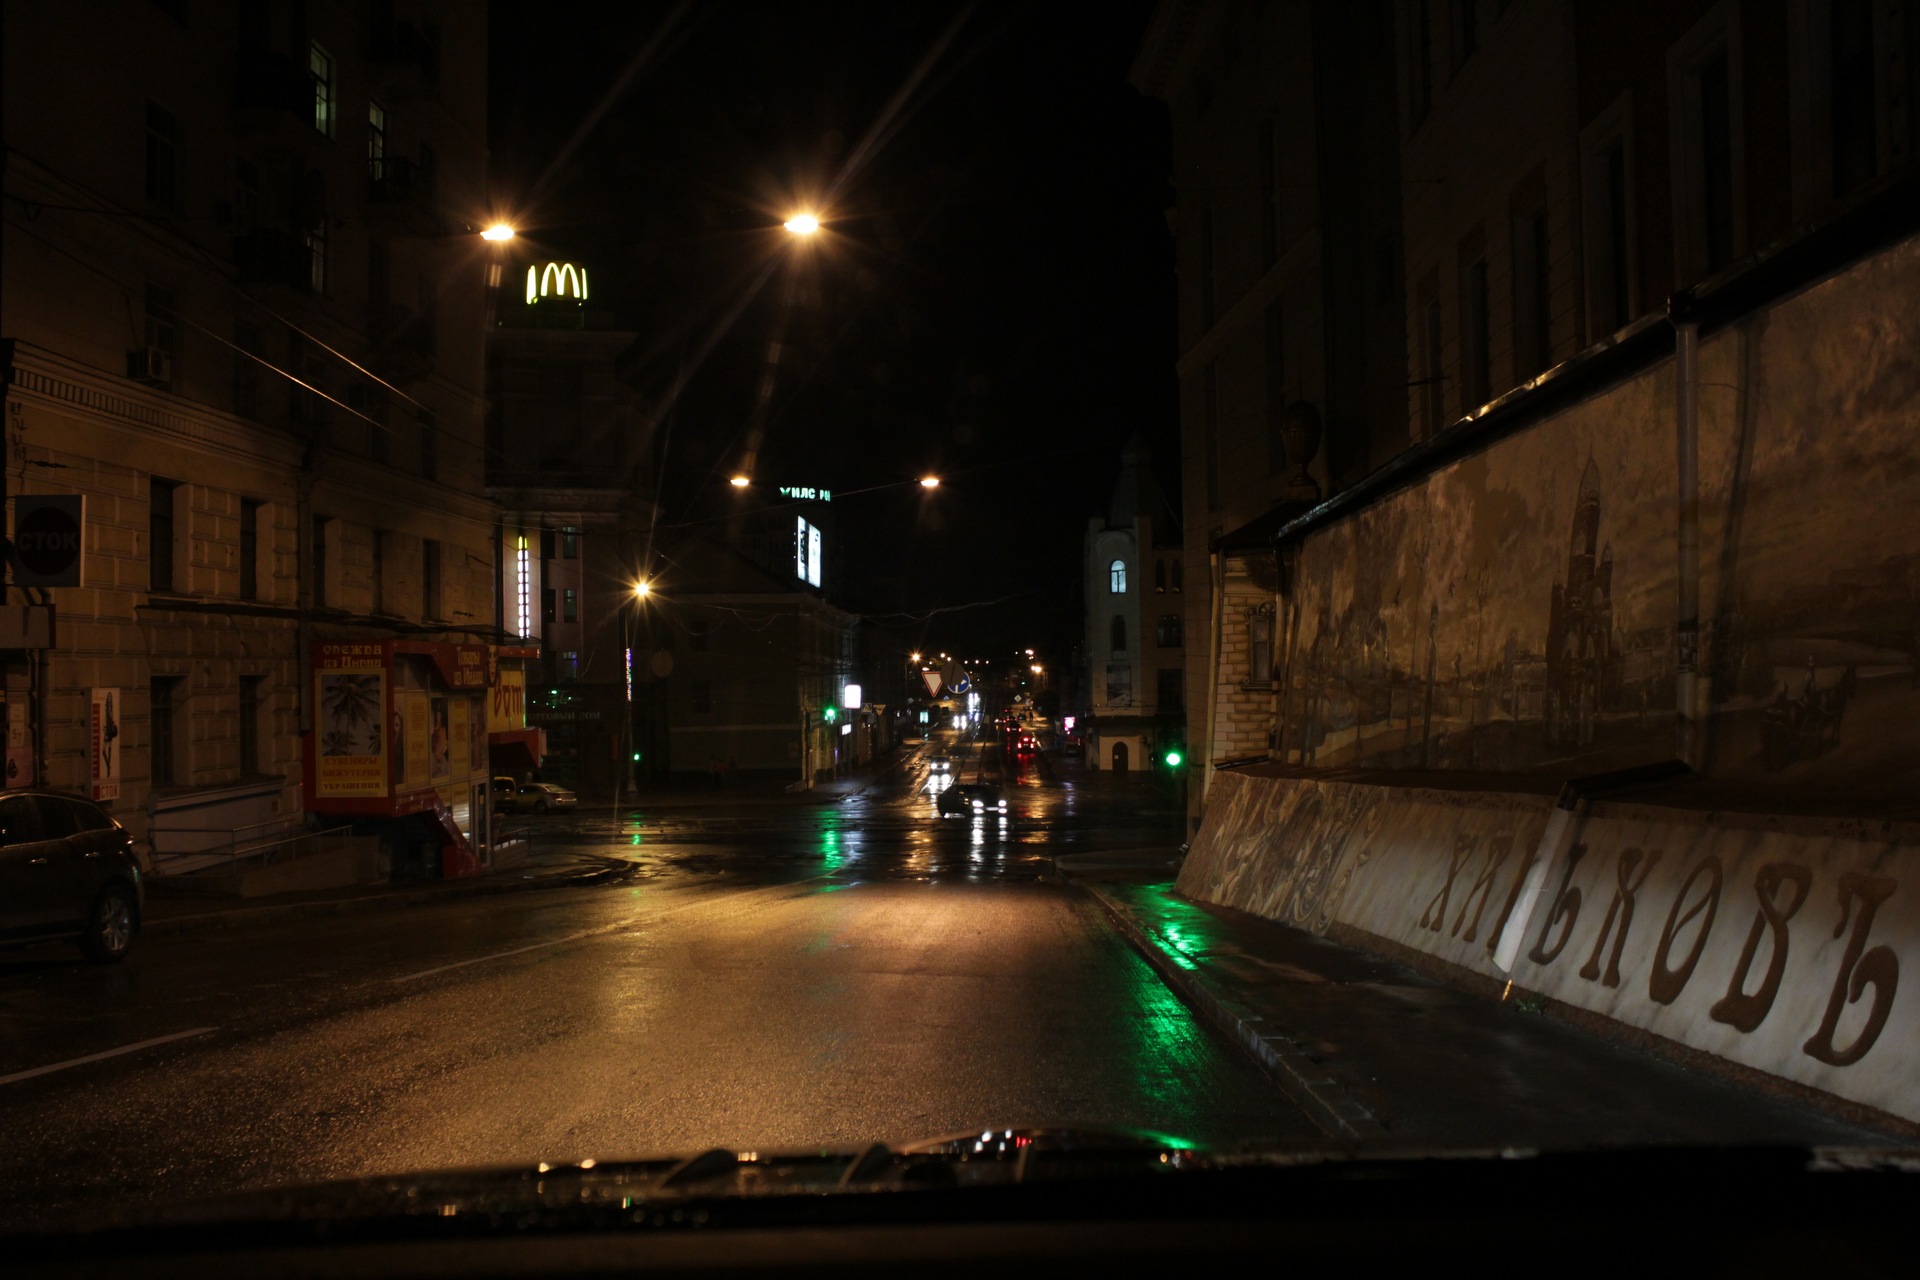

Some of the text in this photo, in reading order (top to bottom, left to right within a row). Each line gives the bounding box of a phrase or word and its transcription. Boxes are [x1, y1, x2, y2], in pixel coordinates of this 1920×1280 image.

[17, 531, 79, 552] СТОК
[324, 757, 378, 766] СУВЕНИРЫ
[322, 768, 381, 778] БИЖУТЕРИЯ
[100, 785, 118, 798] СТОК
[323, 782, 381, 791] УКРАШЕНИЯ
